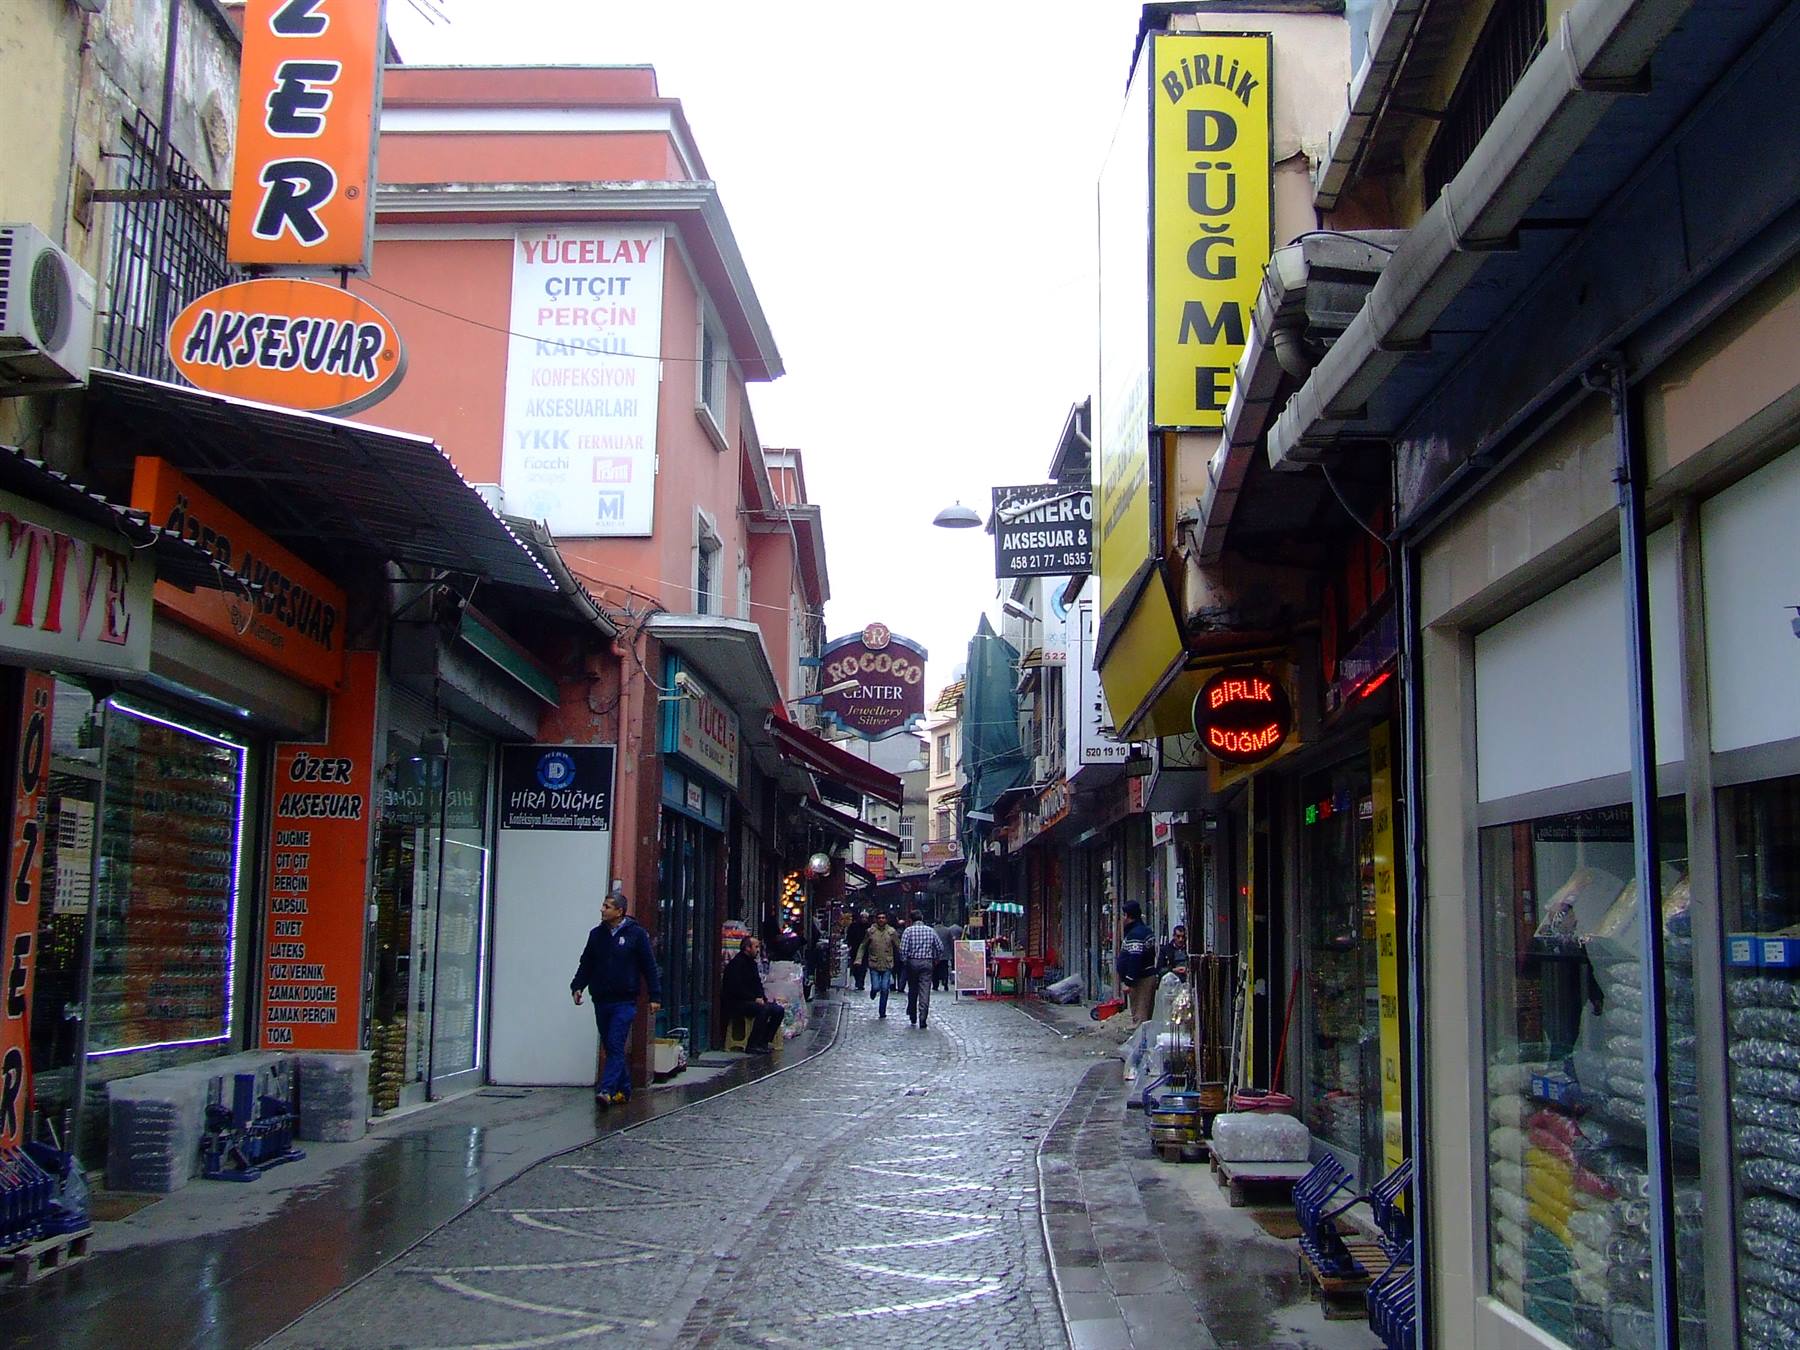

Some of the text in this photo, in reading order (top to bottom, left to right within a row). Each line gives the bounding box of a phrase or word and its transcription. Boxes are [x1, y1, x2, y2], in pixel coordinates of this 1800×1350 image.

[1161, 53, 1259, 107] BİRLİK
[521, 234, 653, 264] YÜCELAY
[1178, 109, 1246, 411] DÜĞME
[537, 302, 636, 331] PERÇİN
[182, 309, 386, 381] AKSESUAR
[535, 332, 634, 357] KAPSÜL
[531, 363, 636, 387] KONFEKSİYON
[525, 398, 638, 418] AKSESUARLARI
[516, 430, 645, 450] YKK FERMUAR
[1003, 529, 1088, 550] AKSESUAR &
[1010, 555, 1028, 569] 458
[1030, 555, 1041, 568] 21
[1044, 554, 1055, 567] 77
[1063, 552, 1086, 566] 0535
[828, 652, 922, 684] ROCOCO
[1210, 679, 1272, 709] BİRLİK
[846, 704, 903, 718] Jewellery
[858, 716, 890, 726] Silver
[1210, 723, 1280, 752] DÜĞME
[1086, 746, 1126, 757] 520 19 10
[289, 752, 353, 785] ÖZER
[278, 792, 363, 820] AKSESUAR
[511, 788, 605, 811] HİRA DÜĞME
[270, 942, 306, 959] LATEKS
[268, 985, 301, 1002] ZAMAK
[267, 1007, 300, 1023] ZAMAK
[266, 1027, 293, 1044] TOKA
